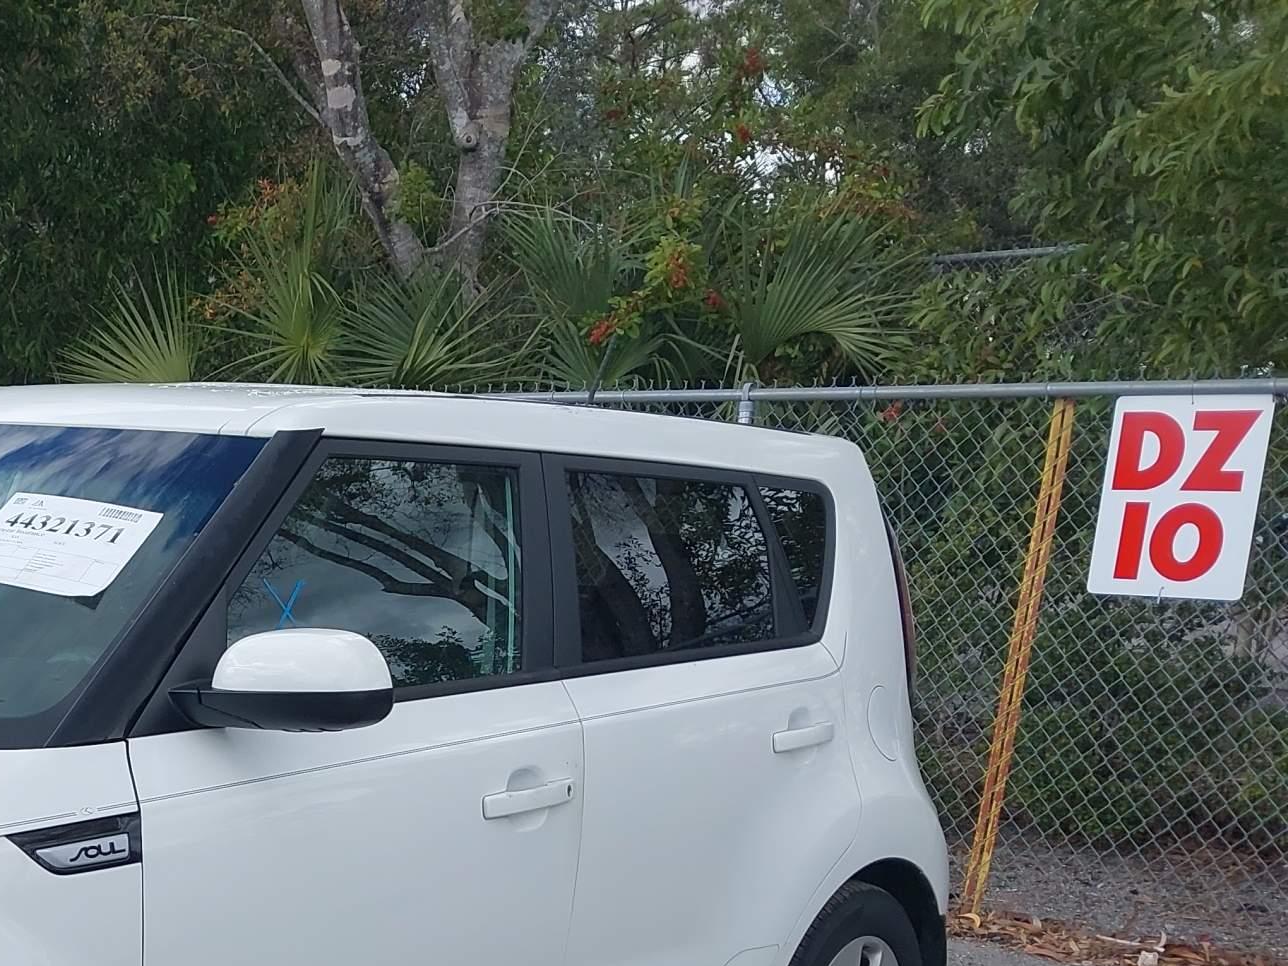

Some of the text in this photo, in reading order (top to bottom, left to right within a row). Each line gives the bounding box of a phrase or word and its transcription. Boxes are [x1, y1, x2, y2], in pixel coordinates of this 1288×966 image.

[1111, 409, 1265, 492] DZ
[4, 512, 125, 544] 44321371
[69, 841, 126, 862] SOUL
